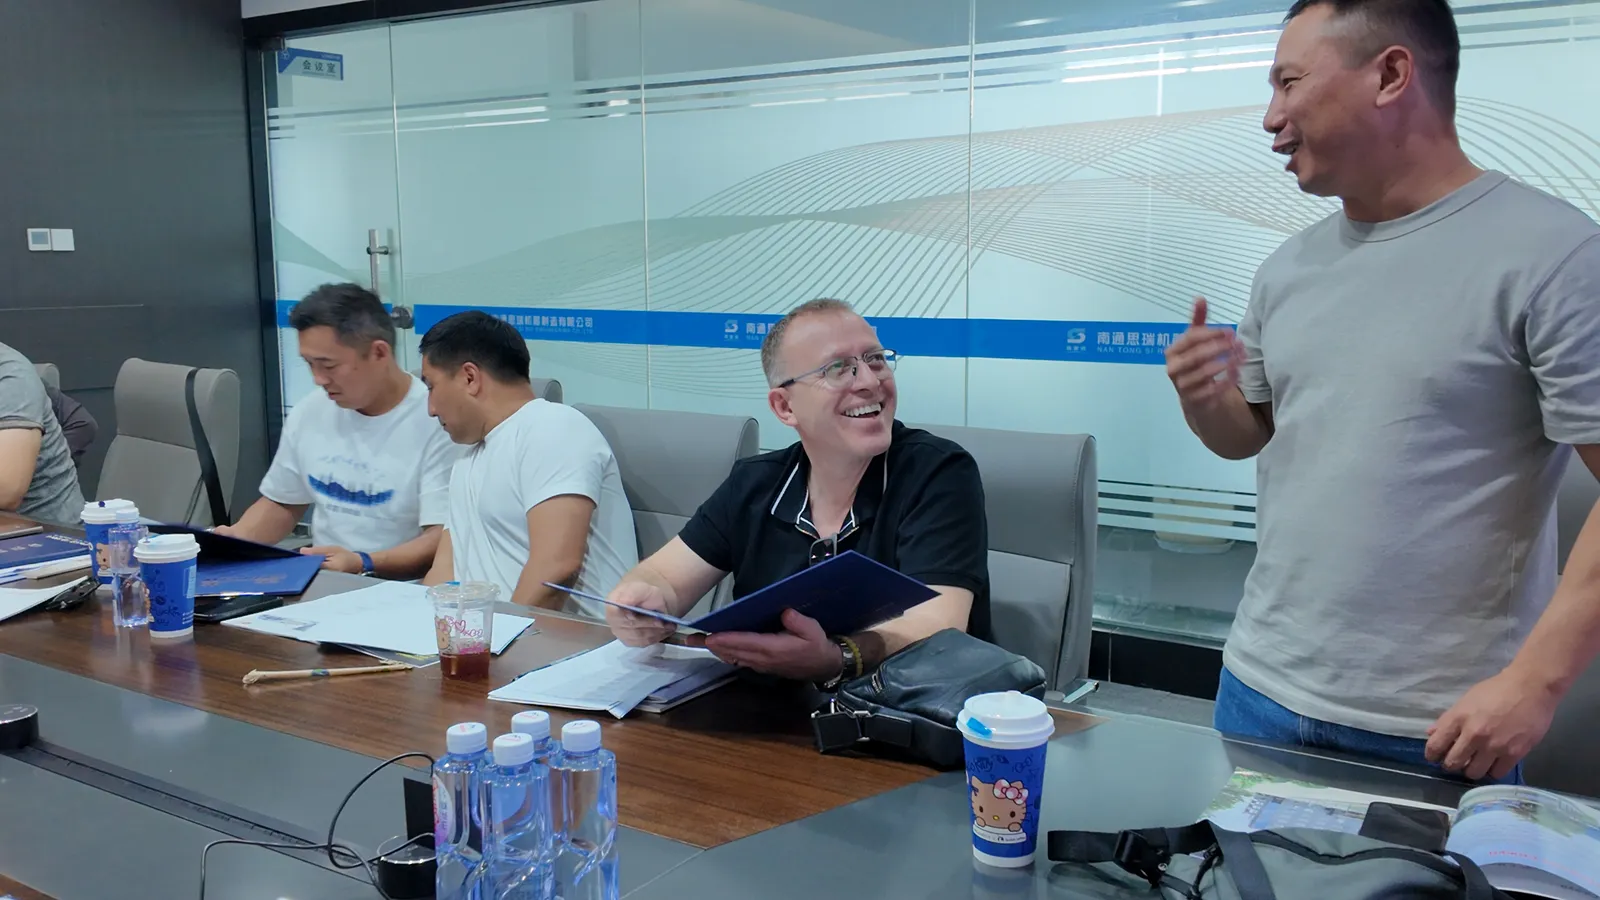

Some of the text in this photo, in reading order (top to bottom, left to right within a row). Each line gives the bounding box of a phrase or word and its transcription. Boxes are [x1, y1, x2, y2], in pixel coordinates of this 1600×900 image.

[303, 60, 336, 73] 会议室
[1118, 346, 1142, 354] TONG
